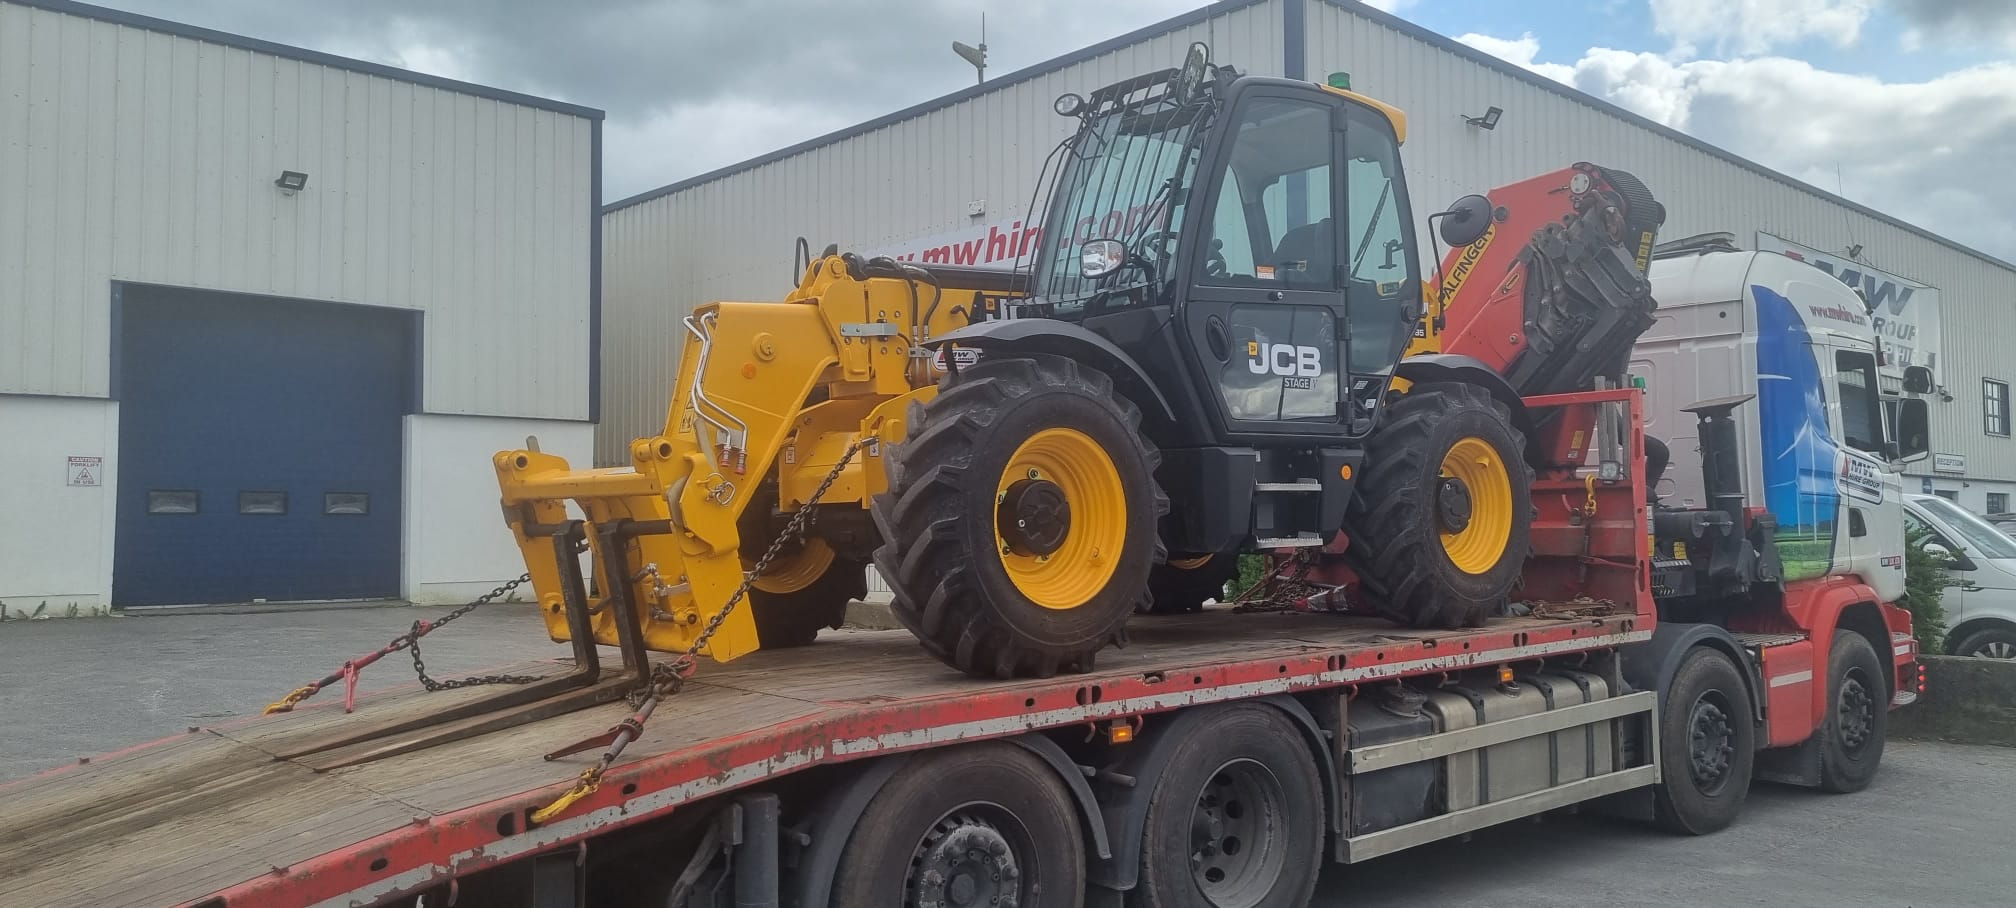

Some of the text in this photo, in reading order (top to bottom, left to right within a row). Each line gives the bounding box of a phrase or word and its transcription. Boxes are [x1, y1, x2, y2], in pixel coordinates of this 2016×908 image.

[1438, 230, 1493, 307] ALFINGE
[1872, 316, 1919, 341] ROUP
[1248, 342, 1322, 377] JCB
[1284, 377, 1310, 389] STAGE
[1936, 457, 1964, 466] RECEPTION
[1848, 472, 1880, 489] HIRE GROUP
